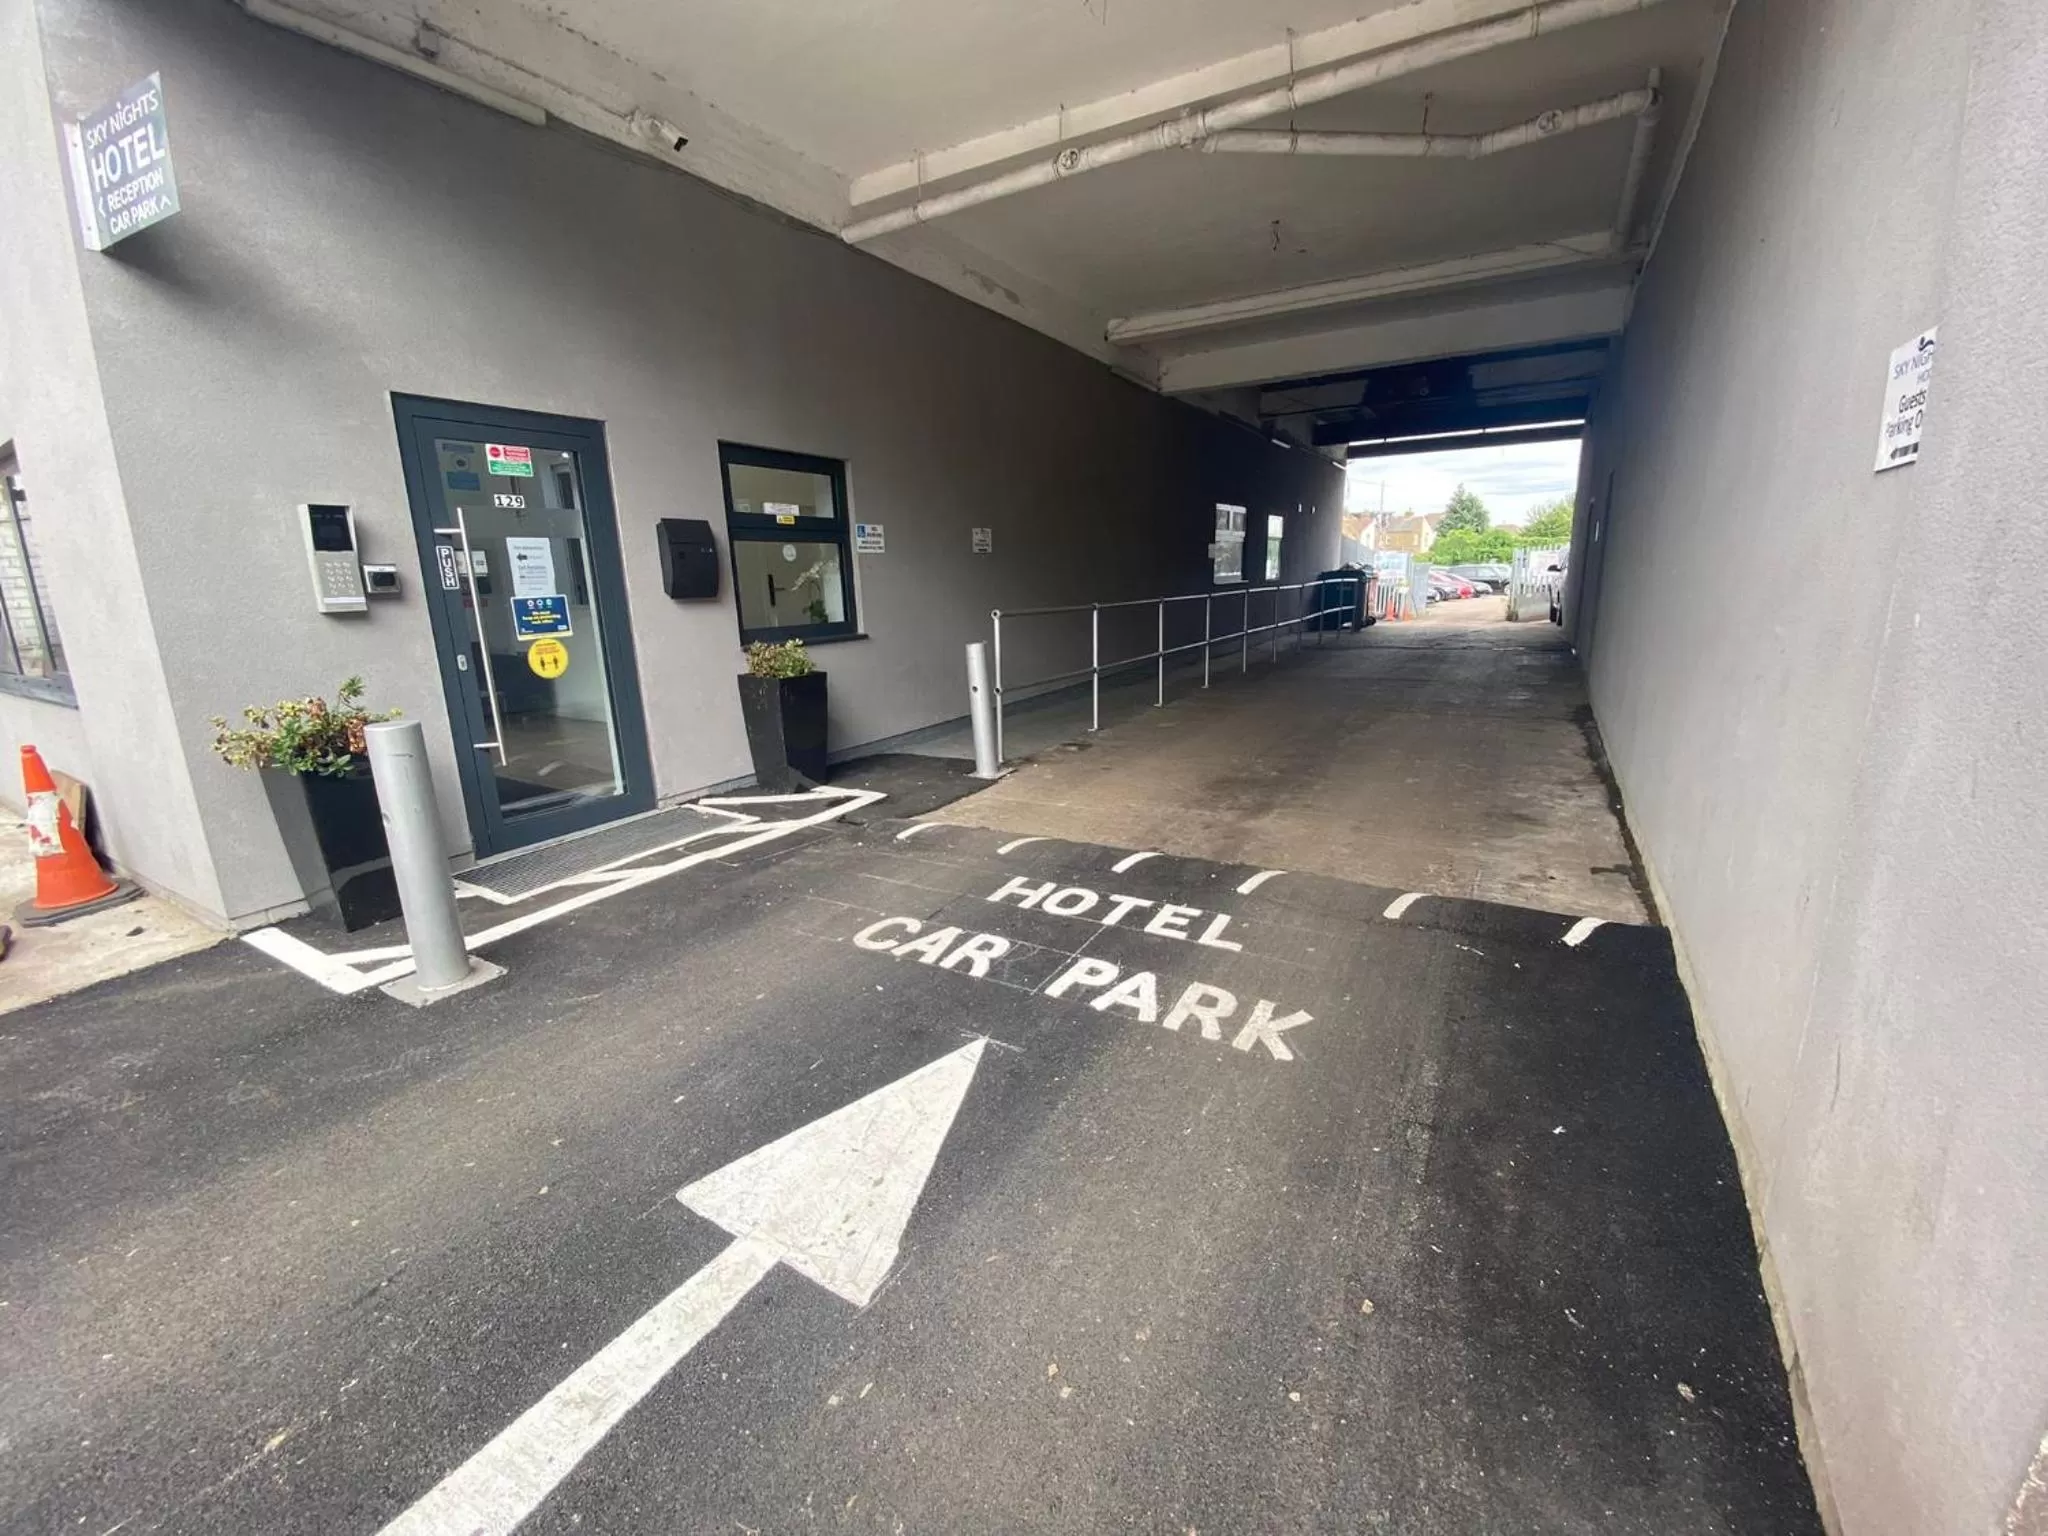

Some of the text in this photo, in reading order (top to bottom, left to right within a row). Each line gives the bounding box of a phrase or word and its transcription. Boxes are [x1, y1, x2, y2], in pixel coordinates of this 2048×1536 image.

[86, 119, 107, 150] SKY
[91, 122, 165, 192] HOTEL
[107, 167, 164, 213] RECEPTION
[110, 195, 160, 235] CAR PARK
[496, 495, 524, 508] 129
[441, 548, 456, 587] PUSH
[986, 876, 1243, 952] HOTEL
[852, 917, 1315, 1061] CAR PARK
